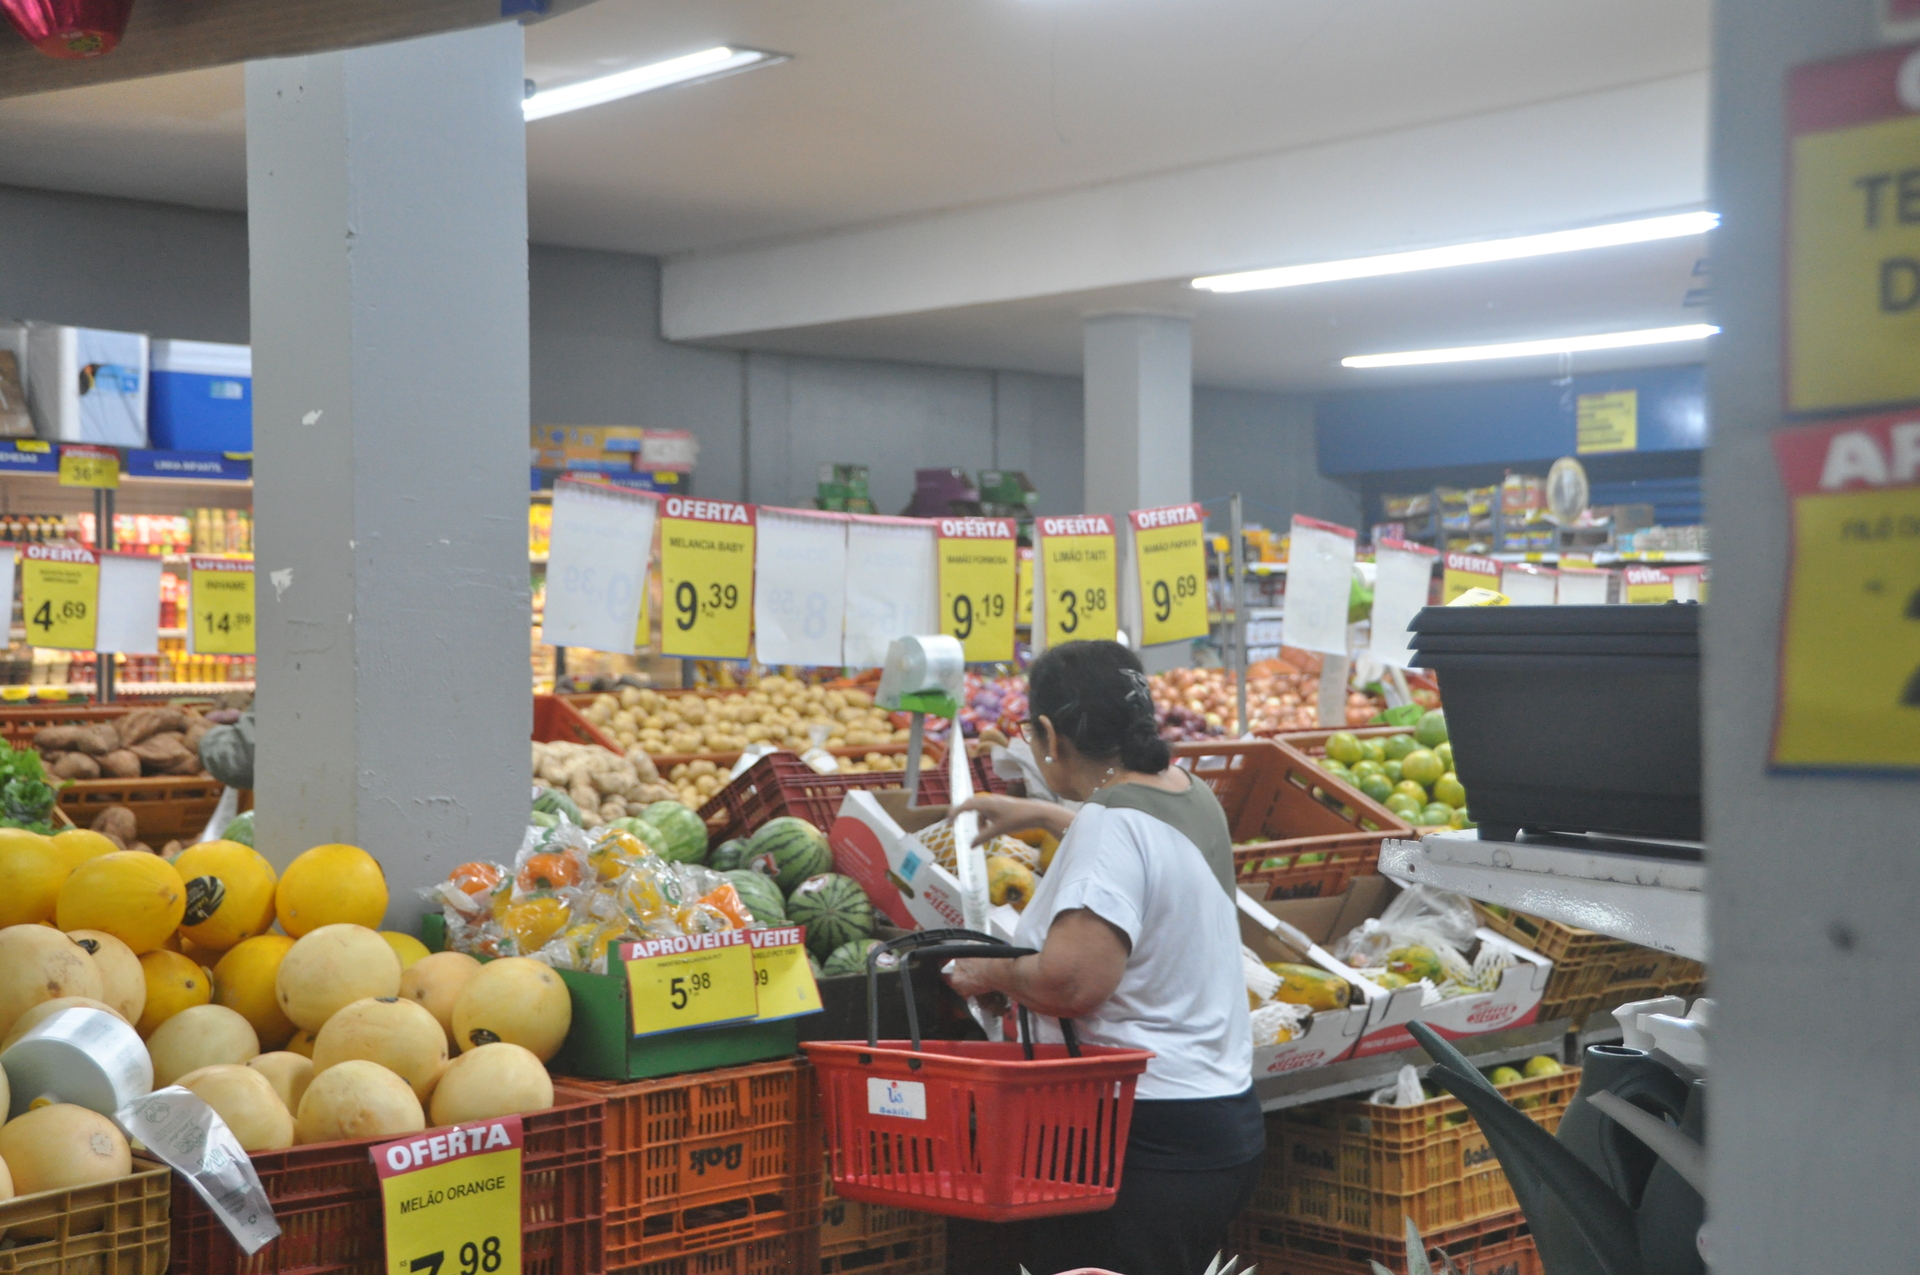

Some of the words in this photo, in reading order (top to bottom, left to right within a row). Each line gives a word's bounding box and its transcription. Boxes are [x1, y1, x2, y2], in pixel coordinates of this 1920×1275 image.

[665, 498, 748, 523] OFERTA
[1137, 506, 1198, 528] OFERTA
[941, 520, 1011, 538] OFERTA
[1043, 518, 1109, 535] OFERTA
[27, 546, 95, 563] OFERTA
[669, 537, 715, 550] MELANCIA
[718, 541, 744, 553] BABY
[1053, 548, 1081, 563] LIMÃO
[1448, 554, 1496, 574] OFERTA
[675, 581, 738, 631] 9,39
[1059, 588, 1107, 633] 3,98
[1152, 575, 1197, 622] 9,69
[33, 600, 87, 632] 4,69
[953, 594, 1004, 640] 9,19
[631, 929, 744, 960] APROVEITE
[670, 972, 711, 1010] 5,98
[386, 1123, 512, 1171] OFERTA
[400, 1190, 443, 1214] MELÃO
[447, 1176, 505, 1200] ORANGE
